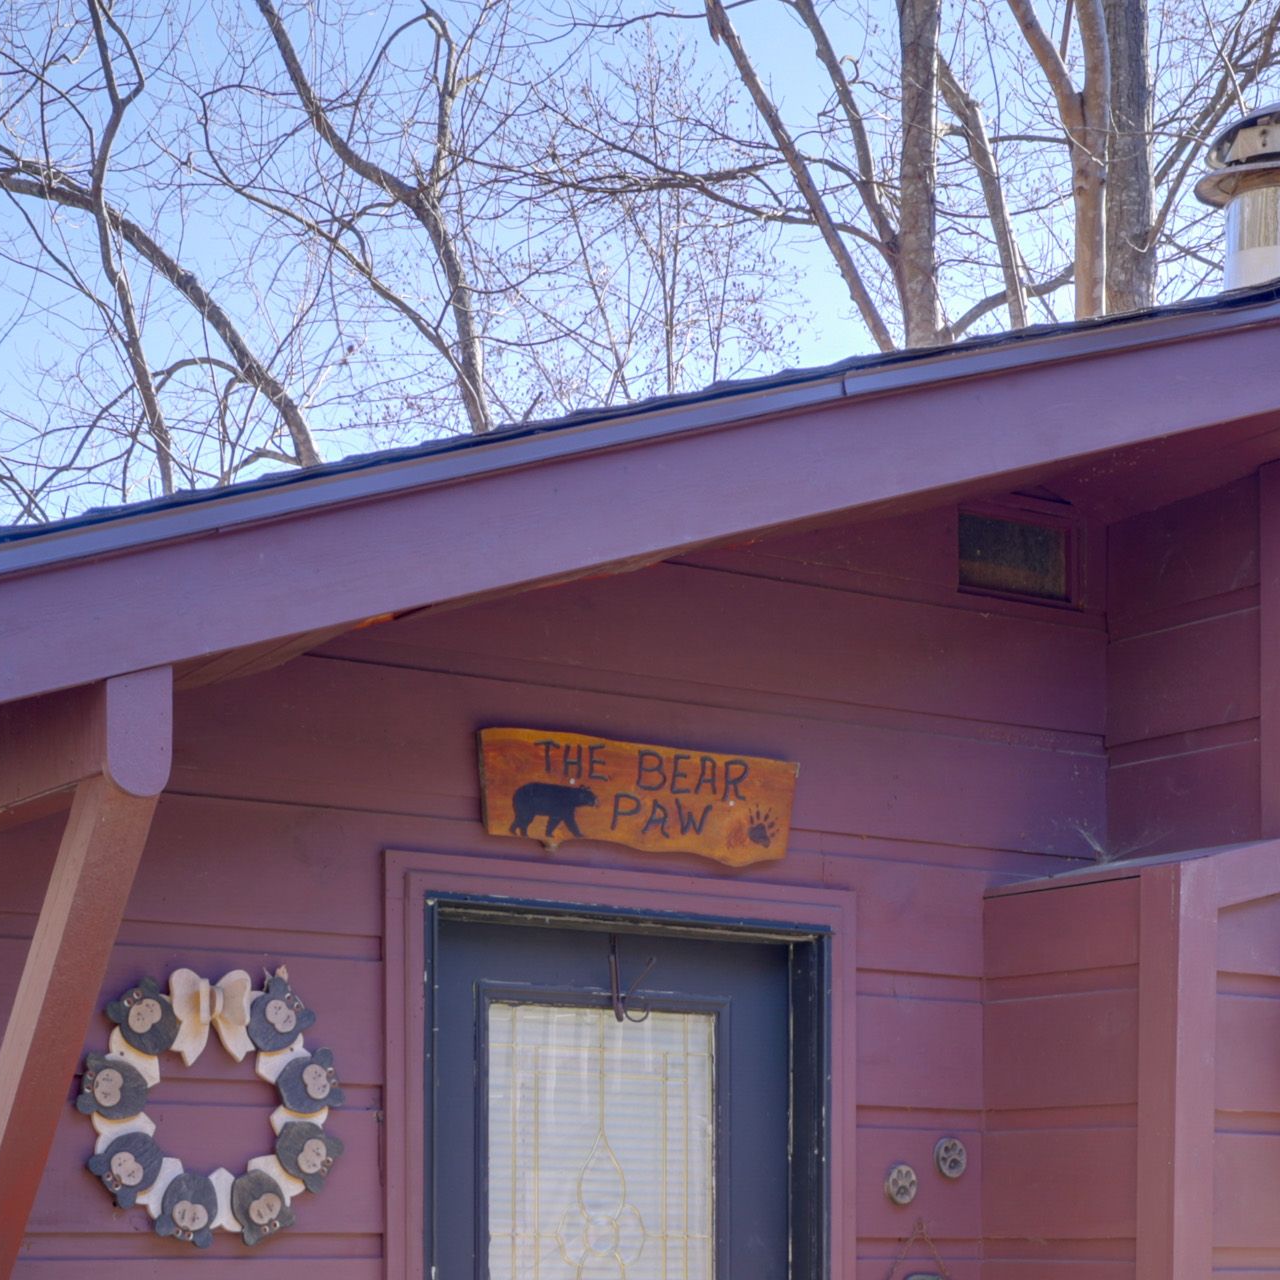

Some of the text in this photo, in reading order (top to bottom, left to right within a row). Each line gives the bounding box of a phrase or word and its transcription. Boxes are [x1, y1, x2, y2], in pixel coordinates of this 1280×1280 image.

[535, 739, 749, 801] THE BEAR
[611, 793, 712, 839] PAW
